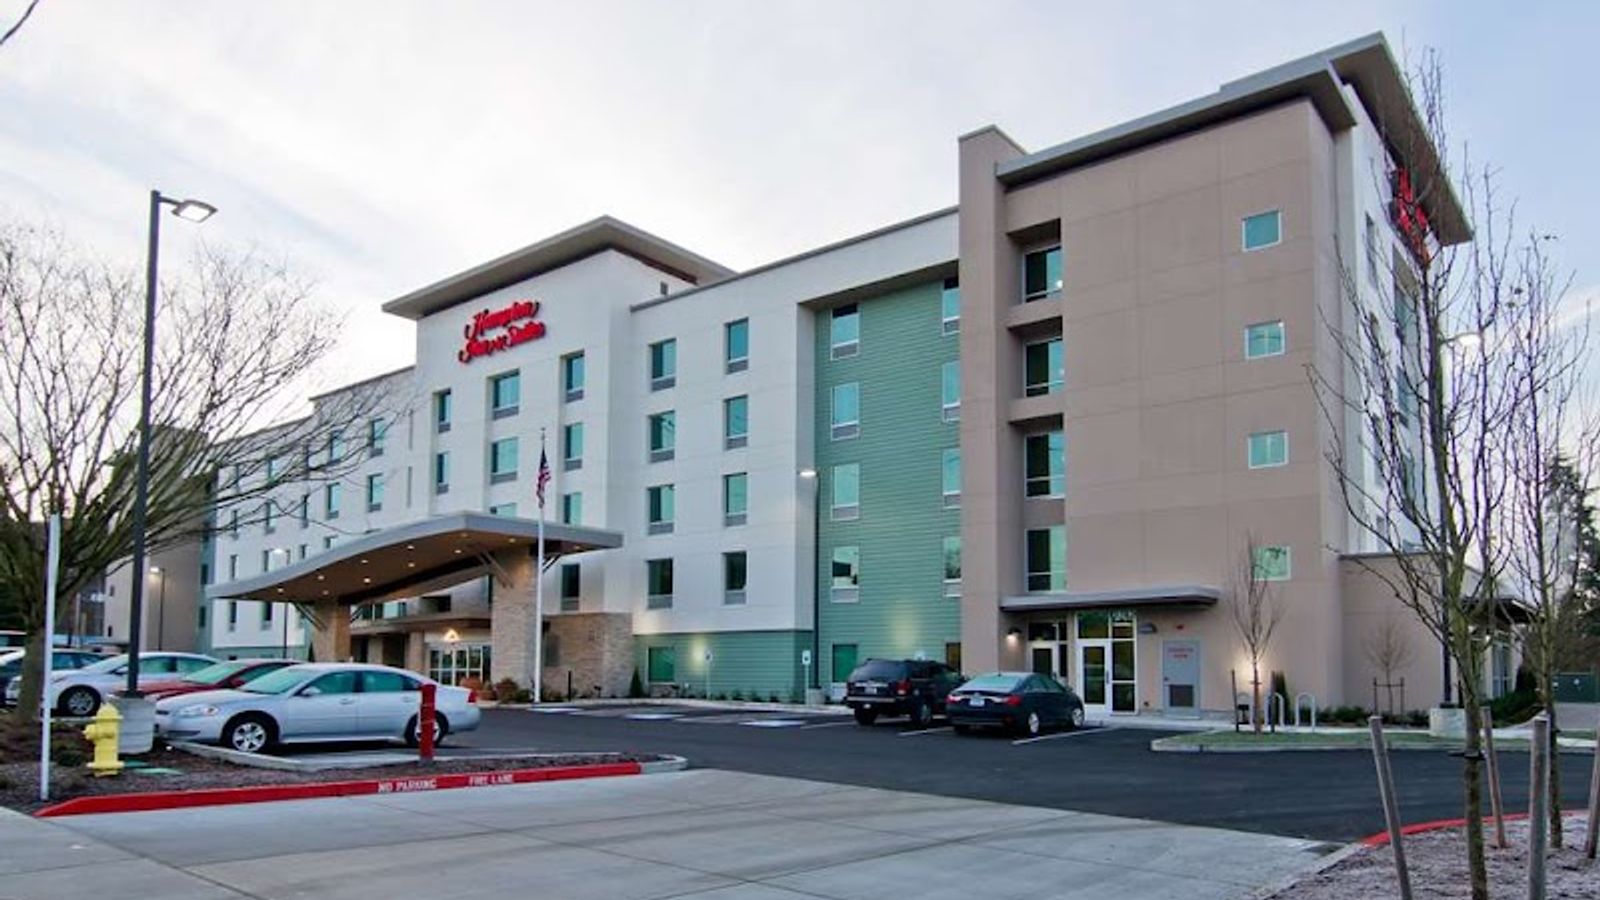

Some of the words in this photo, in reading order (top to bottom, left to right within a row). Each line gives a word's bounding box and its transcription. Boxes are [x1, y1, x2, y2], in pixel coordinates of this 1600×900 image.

[464, 299, 540, 340] Hampton
[378, 781, 393, 793] NO
[396, 779, 437, 791] PARKING
[491, 774, 514, 785] LANE
